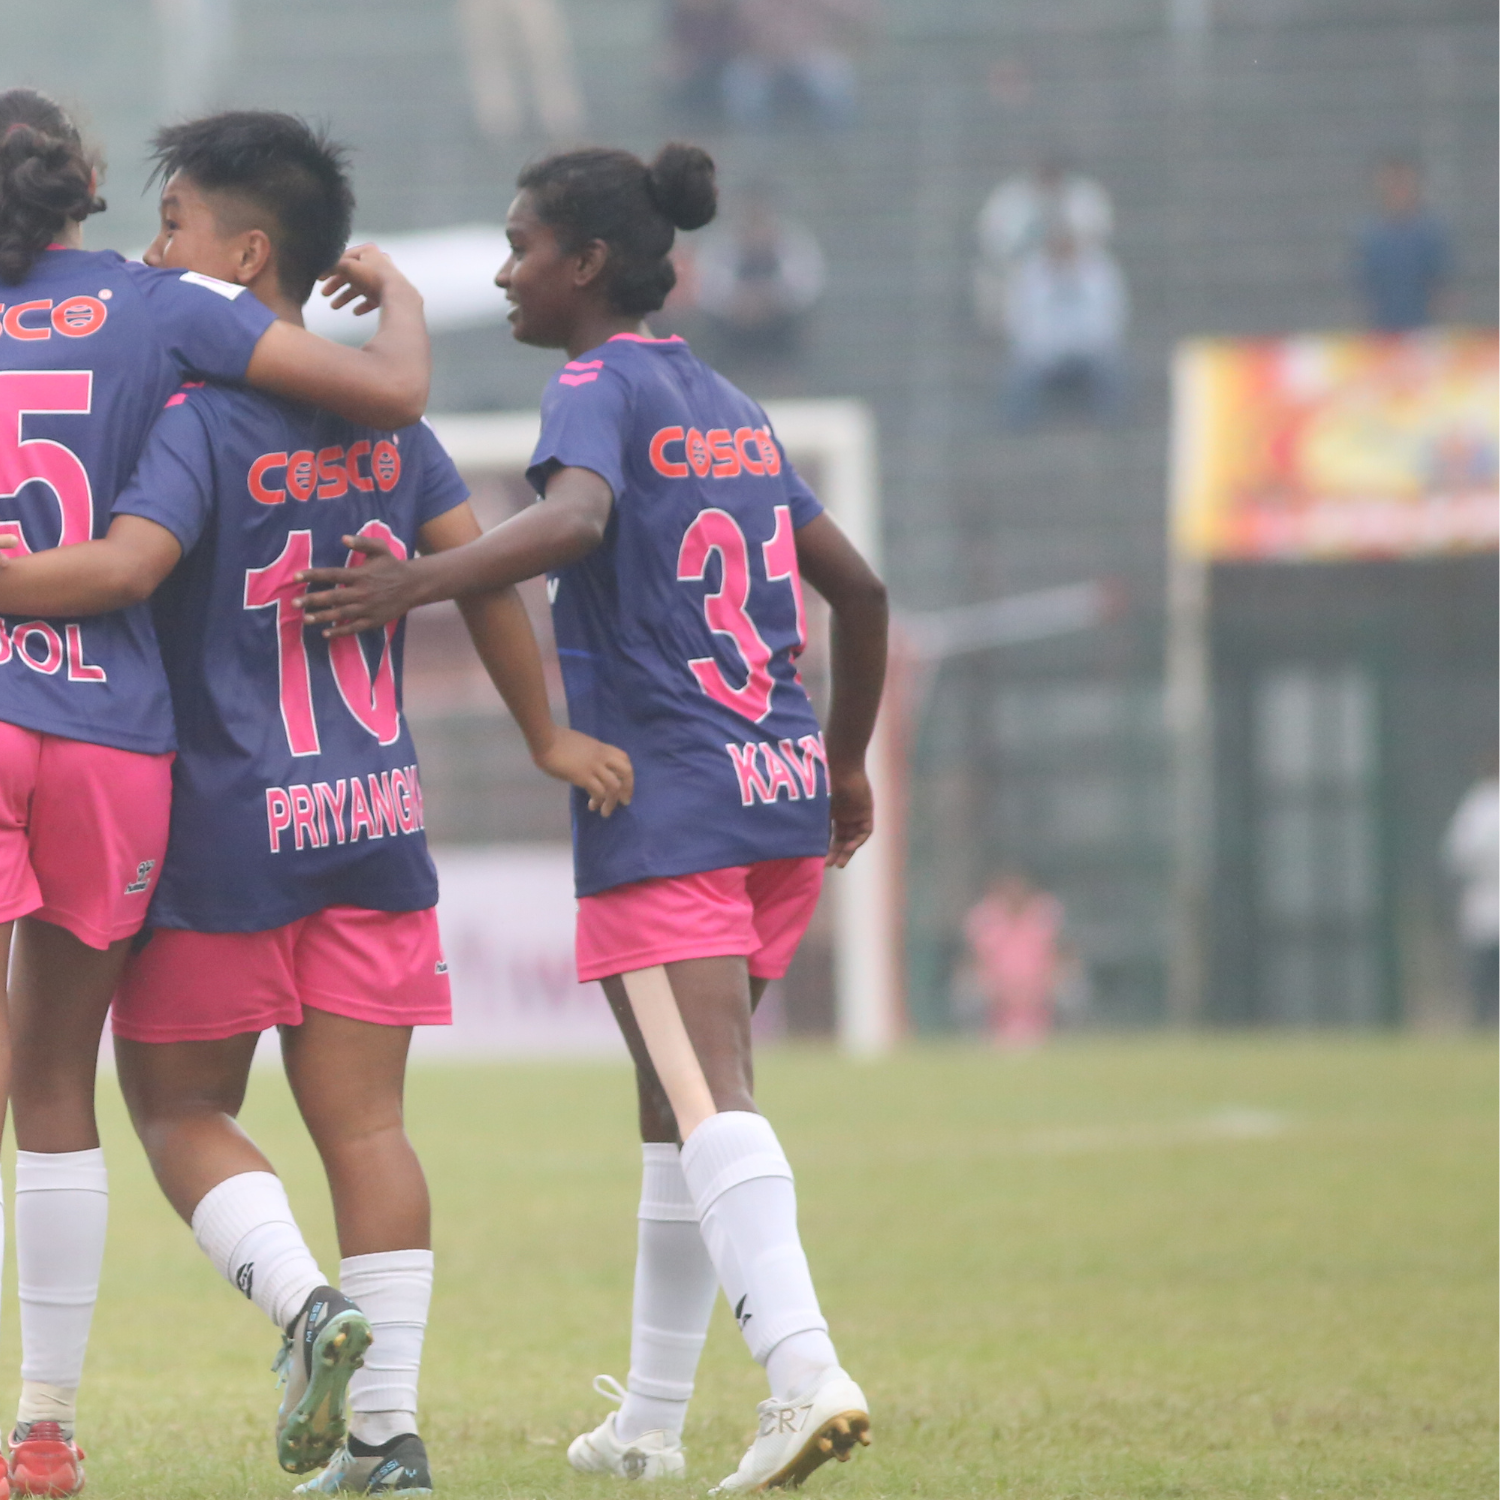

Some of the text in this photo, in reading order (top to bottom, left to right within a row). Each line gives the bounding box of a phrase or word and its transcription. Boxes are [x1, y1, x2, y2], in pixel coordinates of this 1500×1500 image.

[247, 440, 401, 504] COSCO
[649, 426, 781, 478] COSCO
[243, 519, 409, 757] 10
[676, 504, 810, 724] 31
